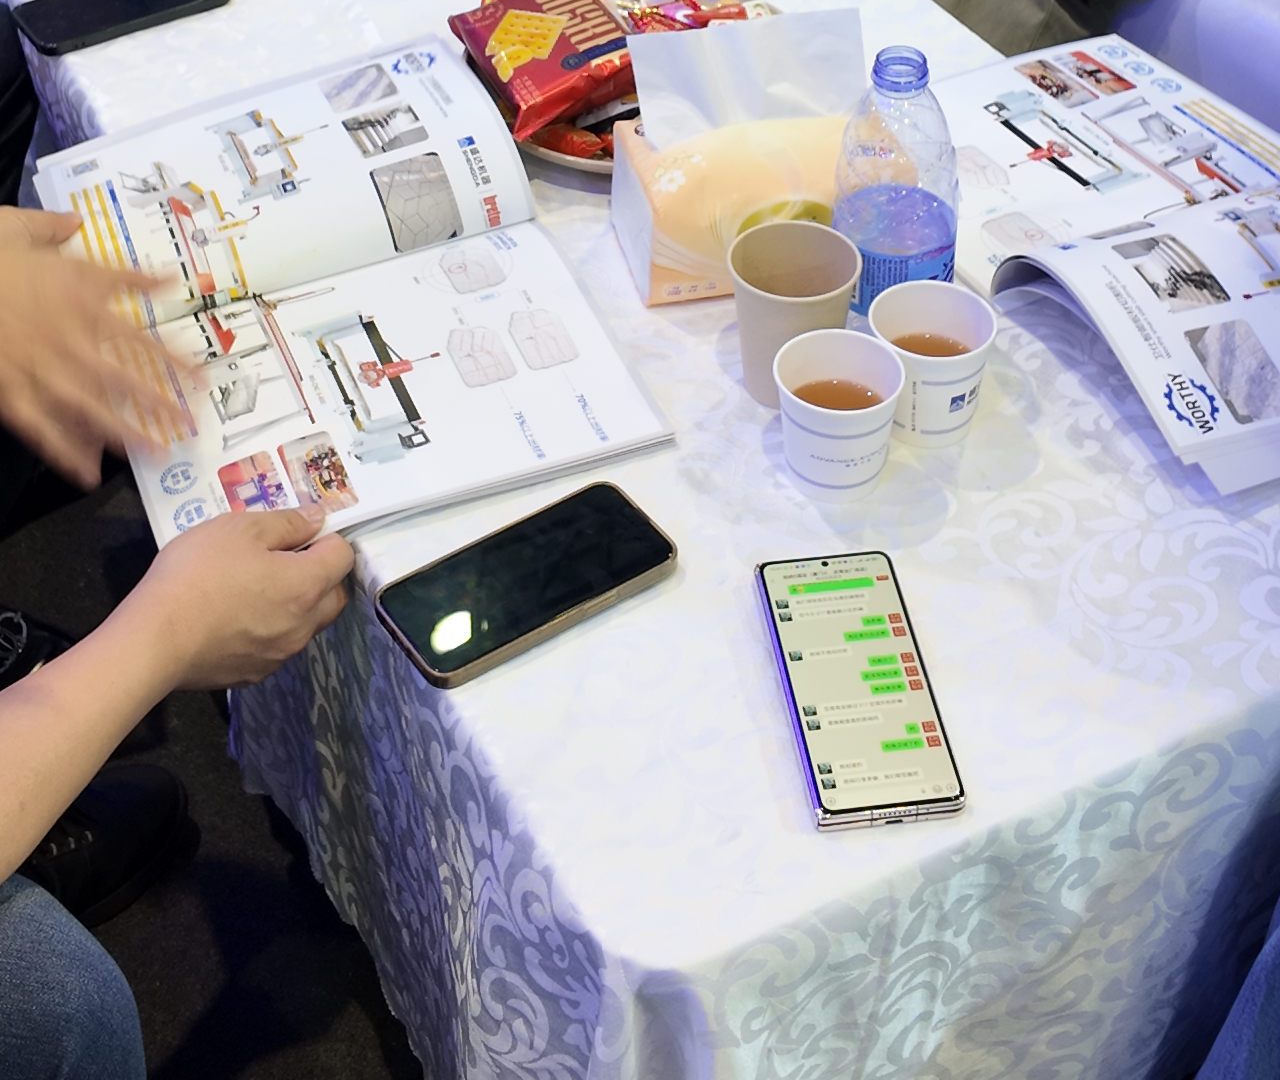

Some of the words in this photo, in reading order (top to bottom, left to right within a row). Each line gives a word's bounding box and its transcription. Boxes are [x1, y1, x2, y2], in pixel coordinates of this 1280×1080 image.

[461, 148, 481, 189] SHENGDA
[469, 146, 492, 186] 盛达机器
[482, 193, 502, 229] breton
[1167, 372, 1214, 435] WORTHY
